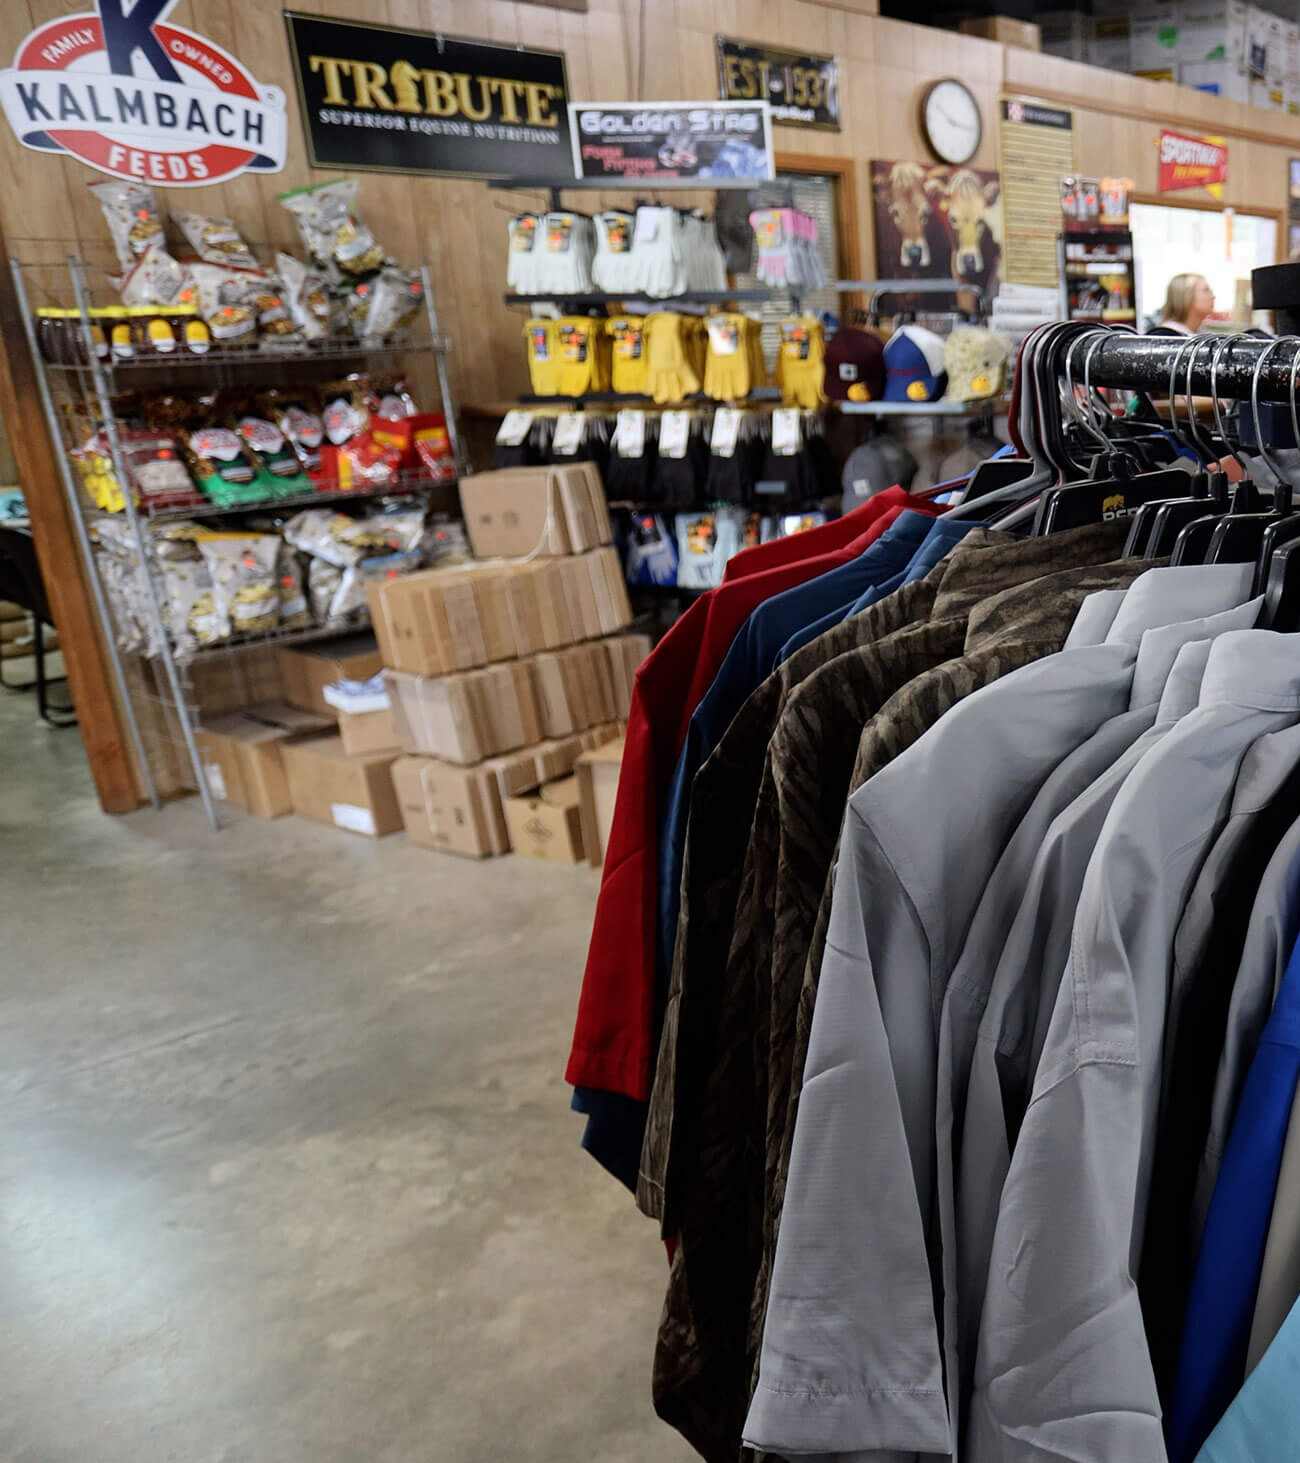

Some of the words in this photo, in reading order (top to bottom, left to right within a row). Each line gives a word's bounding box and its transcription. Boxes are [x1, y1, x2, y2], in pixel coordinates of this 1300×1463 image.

[41, 28, 95, 64] FAMILY
[169, 39, 233, 85] OWNED
[15, 82, 264, 144] KALMBACH
[318, 108, 407, 131] SUPERIOR
[409, 117, 471, 137] EQUINE
[473, 123, 560, 145] NUTRITION
[108, 145, 209, 179] FEEDS
